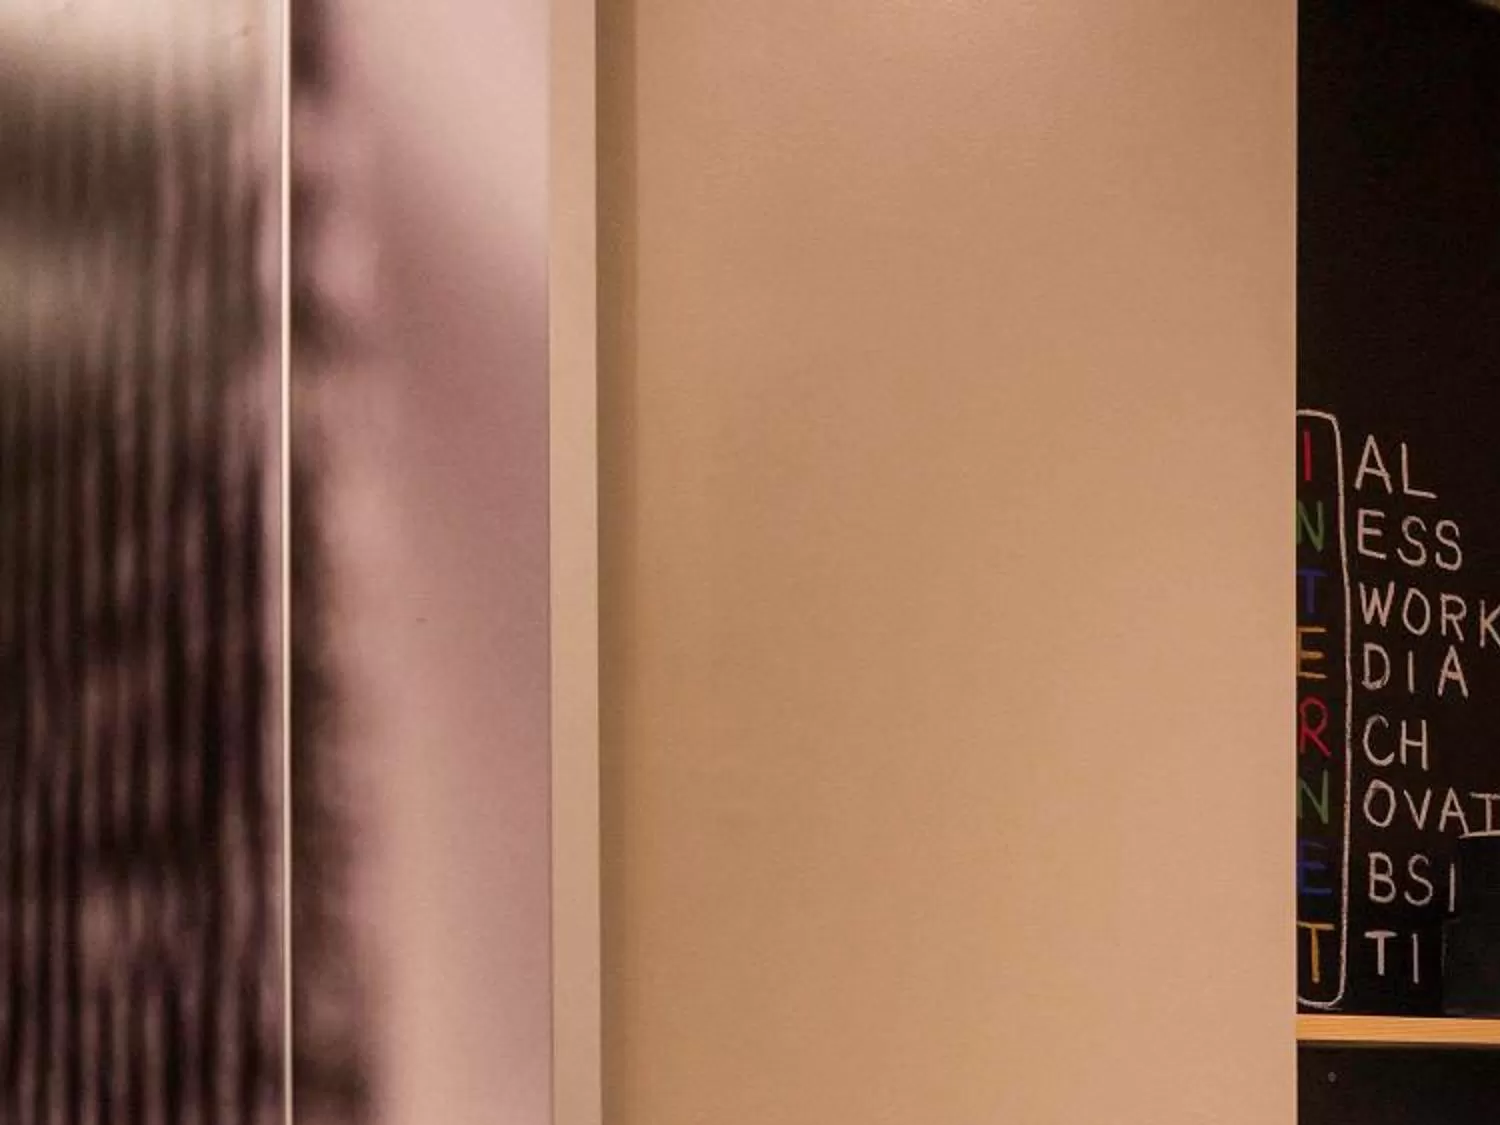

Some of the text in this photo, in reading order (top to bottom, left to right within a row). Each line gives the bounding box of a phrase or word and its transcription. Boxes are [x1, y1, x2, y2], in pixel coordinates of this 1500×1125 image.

[1354, 433, 1438, 499] AL
[1356, 507, 1463, 571] ESS
[1362, 713, 1429, 771] CH
